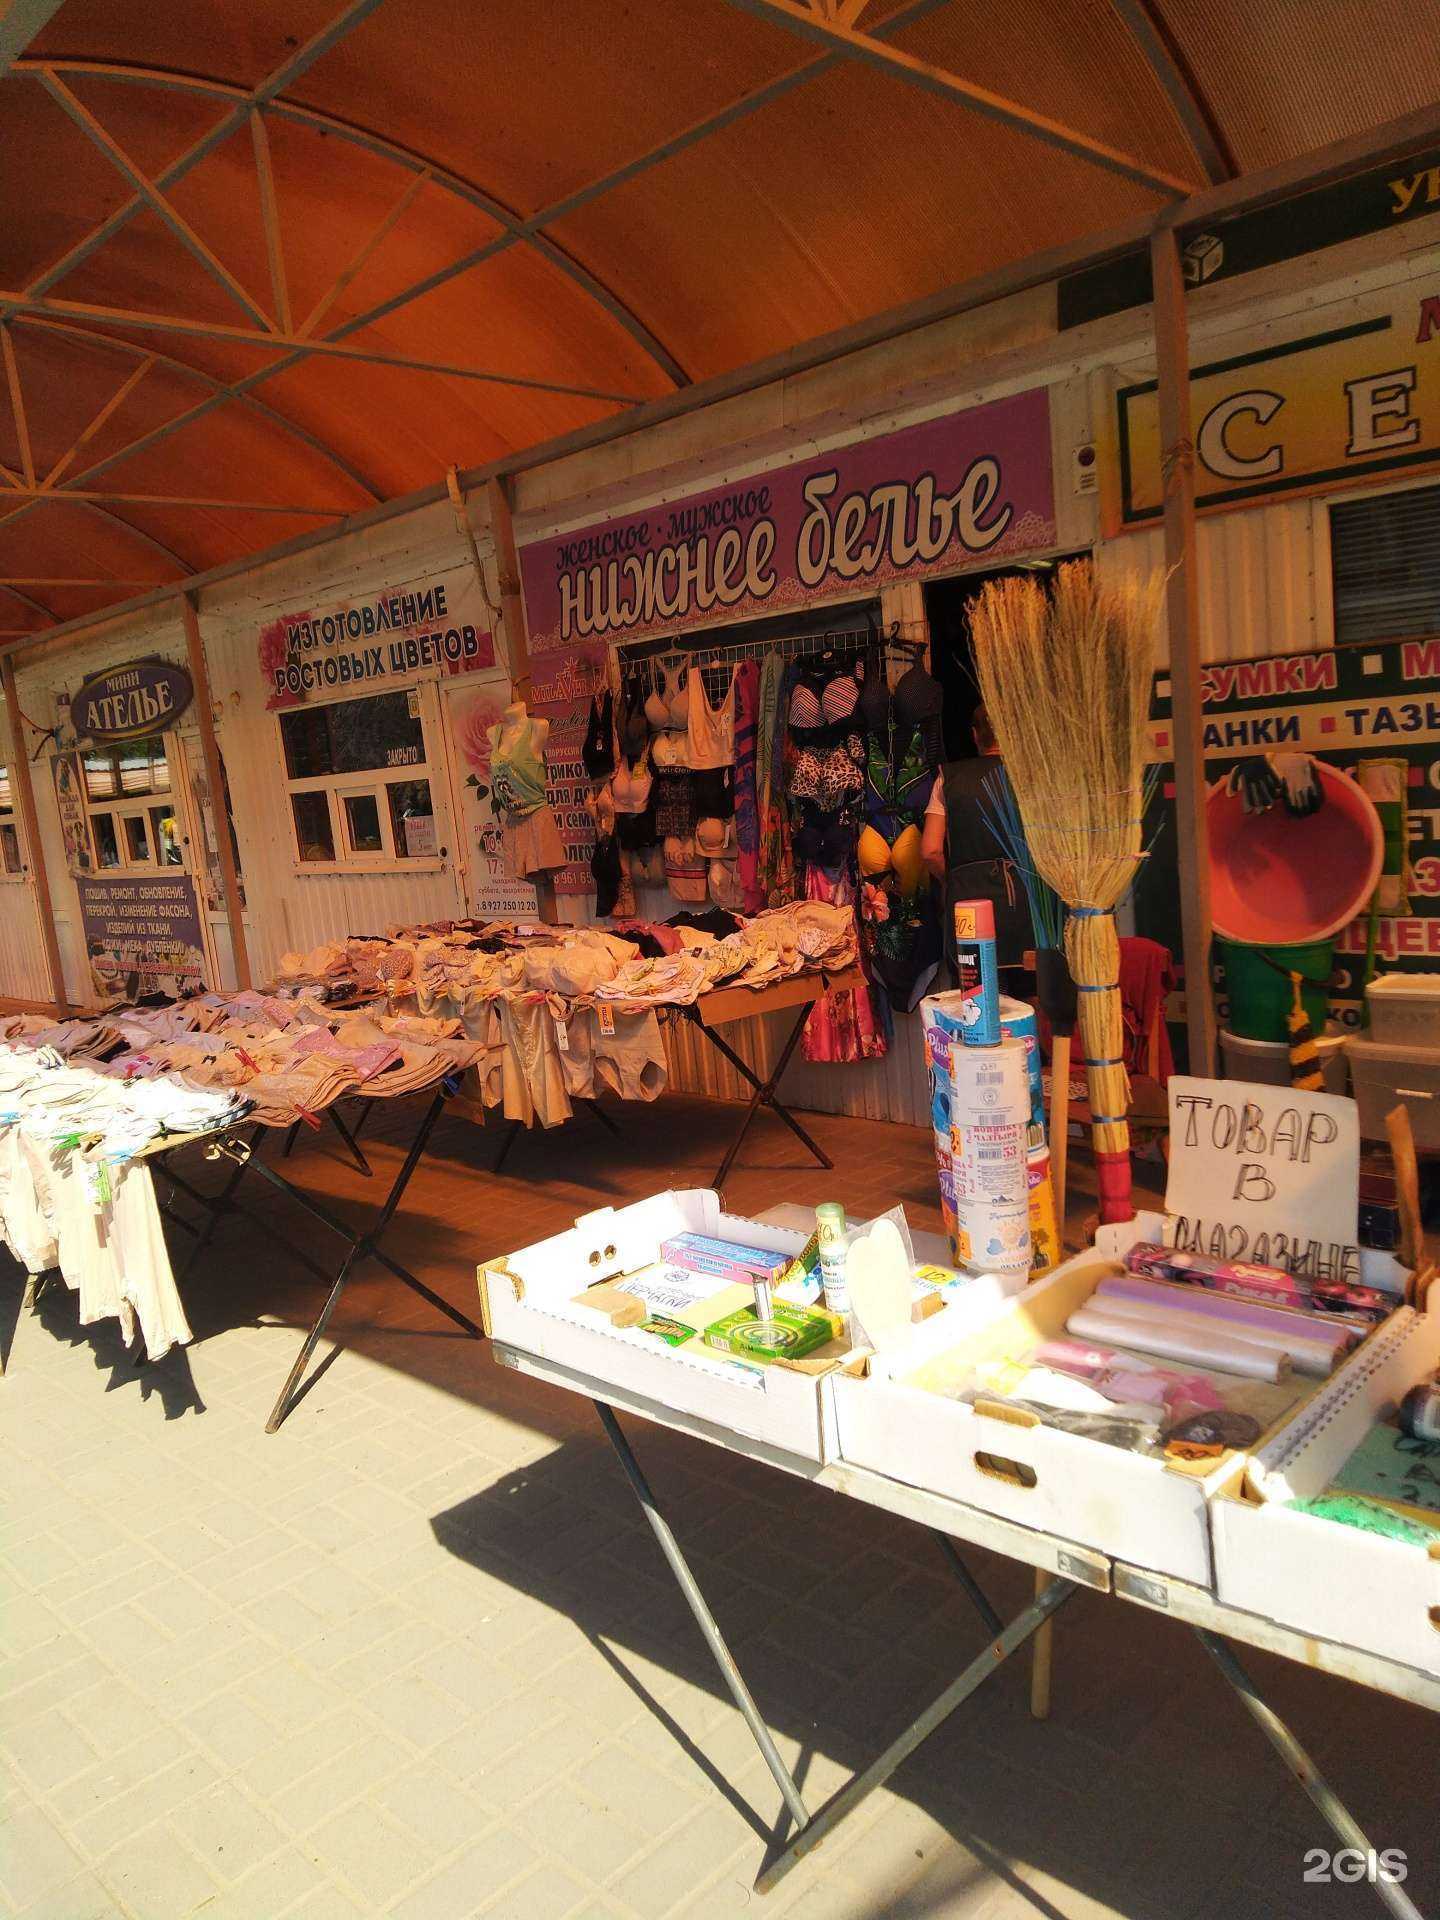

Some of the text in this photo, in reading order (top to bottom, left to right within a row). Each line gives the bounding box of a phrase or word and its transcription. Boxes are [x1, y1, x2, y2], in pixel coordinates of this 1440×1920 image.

[557, 486, 773, 570] женское мужское
[558, 455, 1014, 641] нижнее белье
[288, 585, 448, 651] ИЗГОТОВЛЕНИЕ
[275, 625, 479, 696] РОСТОВЫХ ЦВЕТОВ
[105, 670, 140, 694] МИНИ
[86, 680, 174, 730] АТЕЛЬЕ
[1202, 715, 1301, 749] АНКИ
[386, 746, 417, 766] ЗАКРЫТО
[110, 888, 137, 901] РЕМОНТ,
[139, 886, 188, 901] ОБНОВЛЕНИЕ,
[503, 901, 517, 911] 250
[527, 901, 536, 911] 20
[105, 920, 136, 934] ИЗДЕЛИЙ
[148, 922, 173, 936] ТКАНИ,
[120, 905, 158, 917] ИЗМЕНЕНИЕ
[159, 904, 193, 920] ФАСОНА,
[1176, 1095, 1338, 1163] ТОВАР
[1233, 1163, 1277, 1202] В
